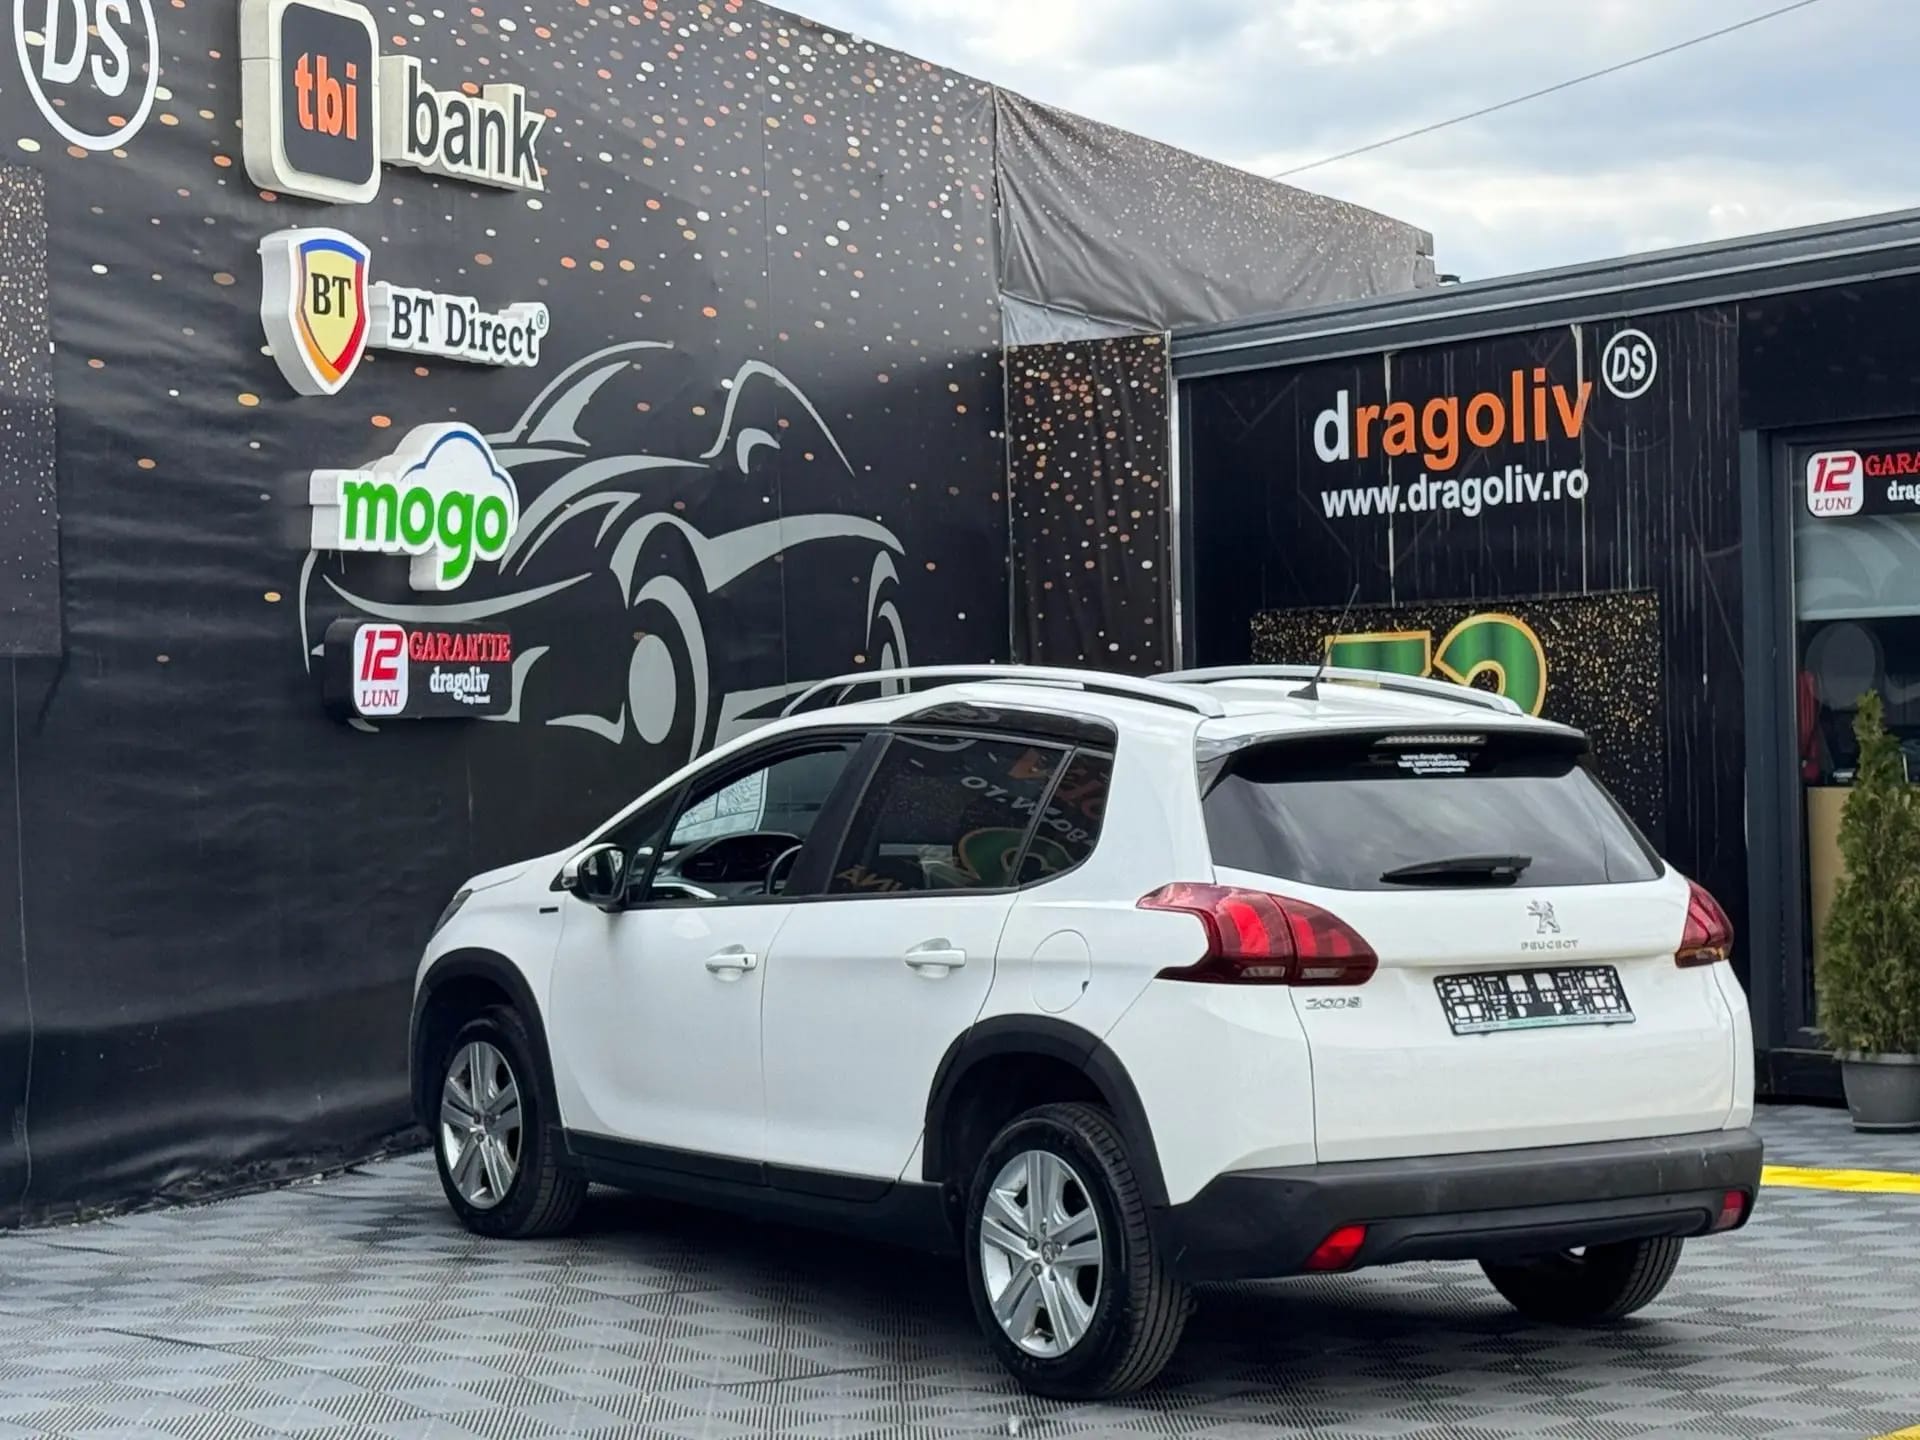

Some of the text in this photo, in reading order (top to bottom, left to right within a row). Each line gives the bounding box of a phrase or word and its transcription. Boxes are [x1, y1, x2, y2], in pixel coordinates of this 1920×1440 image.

[42, 0, 131, 97] DS
[294, 53, 541, 182] tbi bank
[312, 273, 351, 318] BT
[391, 294, 434, 343] BT
[1612, 345, 1647, 382] DS
[1313, 367, 1593, 471] dragoliv
[1321, 464, 1590, 518] www.dragoliv.ro
[1814, 456, 1856, 493] 12
[1815, 497, 1853, 511] LUNI
[343, 481, 508, 581] mogo
[360, 630, 403, 681] 12
[408, 631, 512, 662] GARANTIE
[361, 689, 399, 707] LUNI
[429, 666, 490, 701] dragoliv
